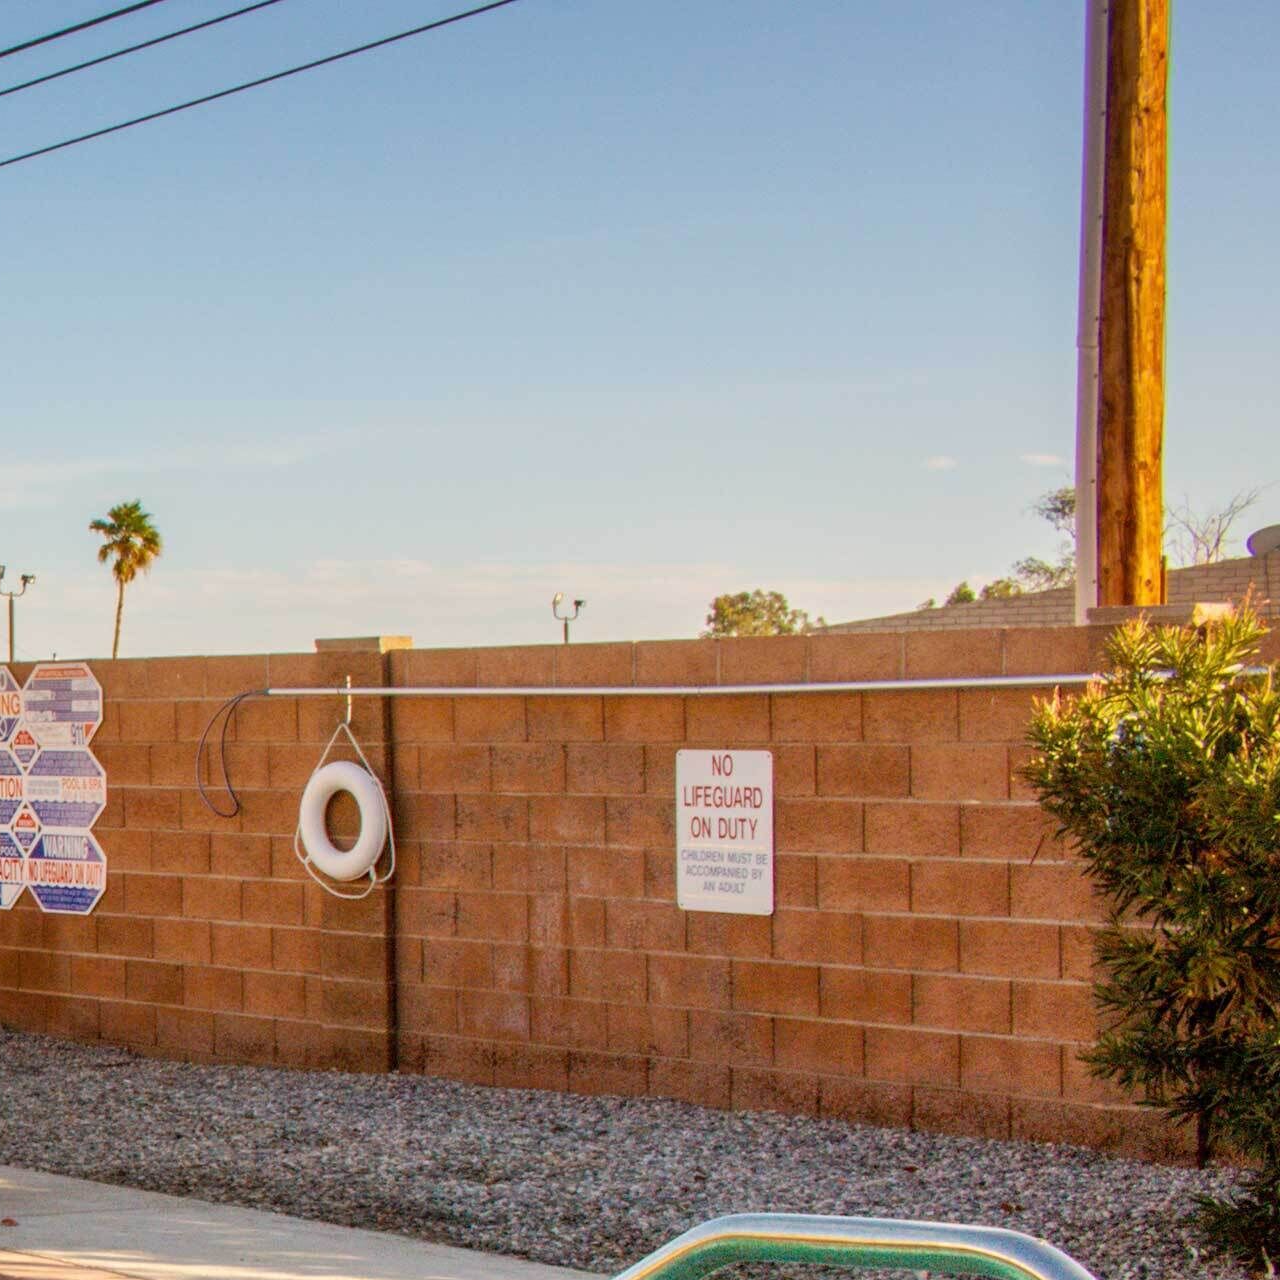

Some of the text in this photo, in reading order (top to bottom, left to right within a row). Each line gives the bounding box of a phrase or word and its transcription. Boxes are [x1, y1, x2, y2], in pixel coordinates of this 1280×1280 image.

[71, 722, 85, 745] 911
[712, 754, 733, 777] NO
[683, 786, 763, 809] LIFEGUARD
[691, 816, 758, 840] ON DUTY
[42, 835, 88, 860] WARNING
[681, 849, 768, 865] CHILDREN MUST BE
[29, 861, 103, 886] NO LIFEGUARD ON DUTY
[686, 865, 764, 880] ACCOMPANIED BY
[703, 881, 745, 894] AN ADULT
